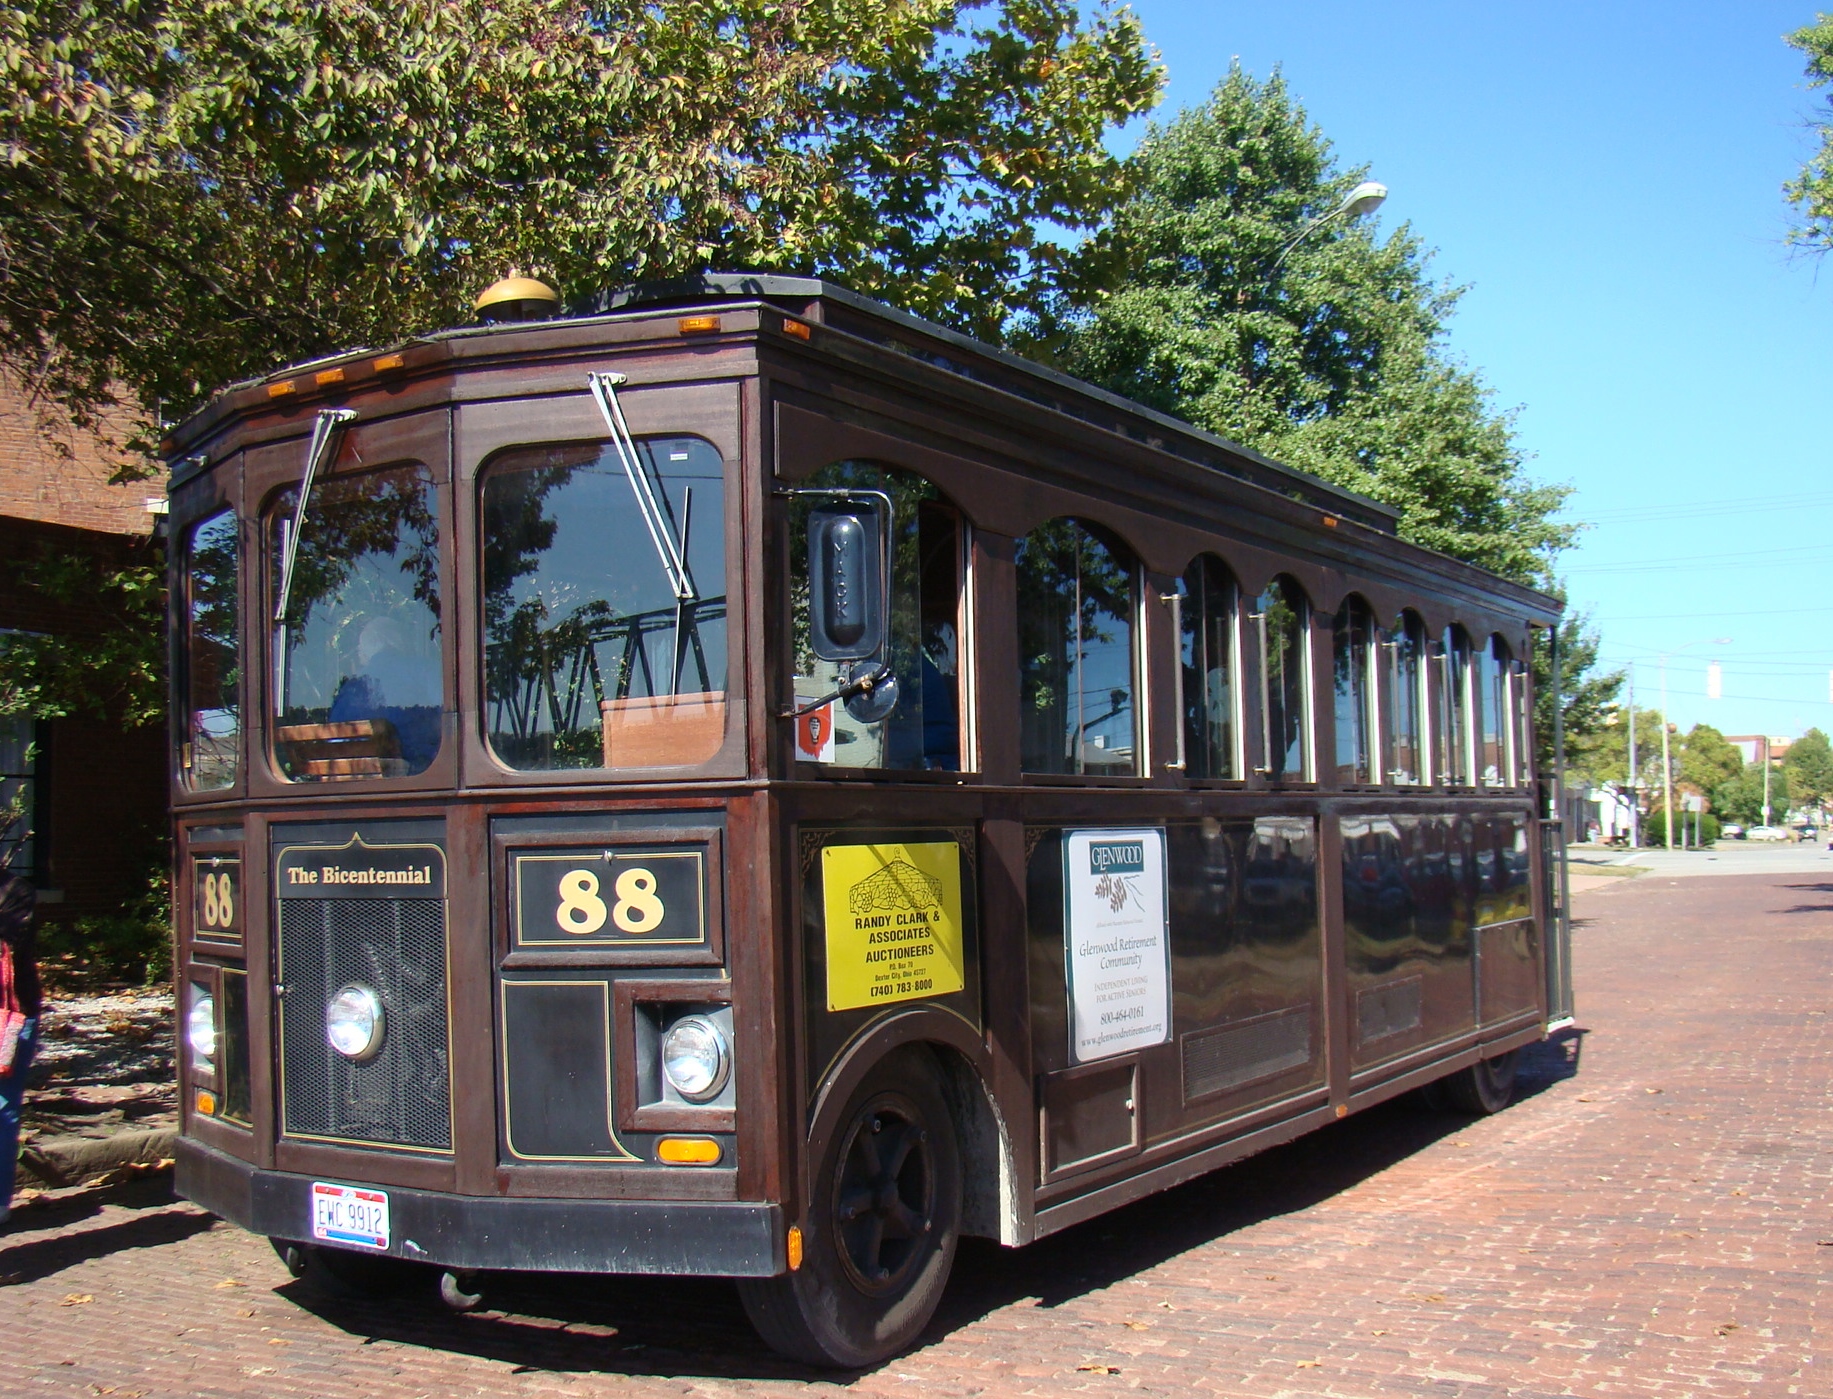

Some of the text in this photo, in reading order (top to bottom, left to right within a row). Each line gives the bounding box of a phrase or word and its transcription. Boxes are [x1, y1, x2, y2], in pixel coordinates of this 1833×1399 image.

[1091, 846, 1142, 871] GLENWOOD
[287, 865, 431, 885] The Bicentennial
[205, 873, 234, 928] 88
[556, 867, 665, 935] 88
[855, 910, 940, 929] RANDY CLARK &
[869, 926, 931, 944] ASSOCIATES
[866, 944, 934, 963] AUCTIONEERS
[1079, 936, 1157, 957] Glenwood Retirement
[1100, 951, 1143, 970] Community
[870, 984, 893, 997] (740)
[1094, 978, 1130, 992] INDEPENDENT
[1096, 994, 1107, 1003] FOR
[348, 1203, 382, 1235] 9912
